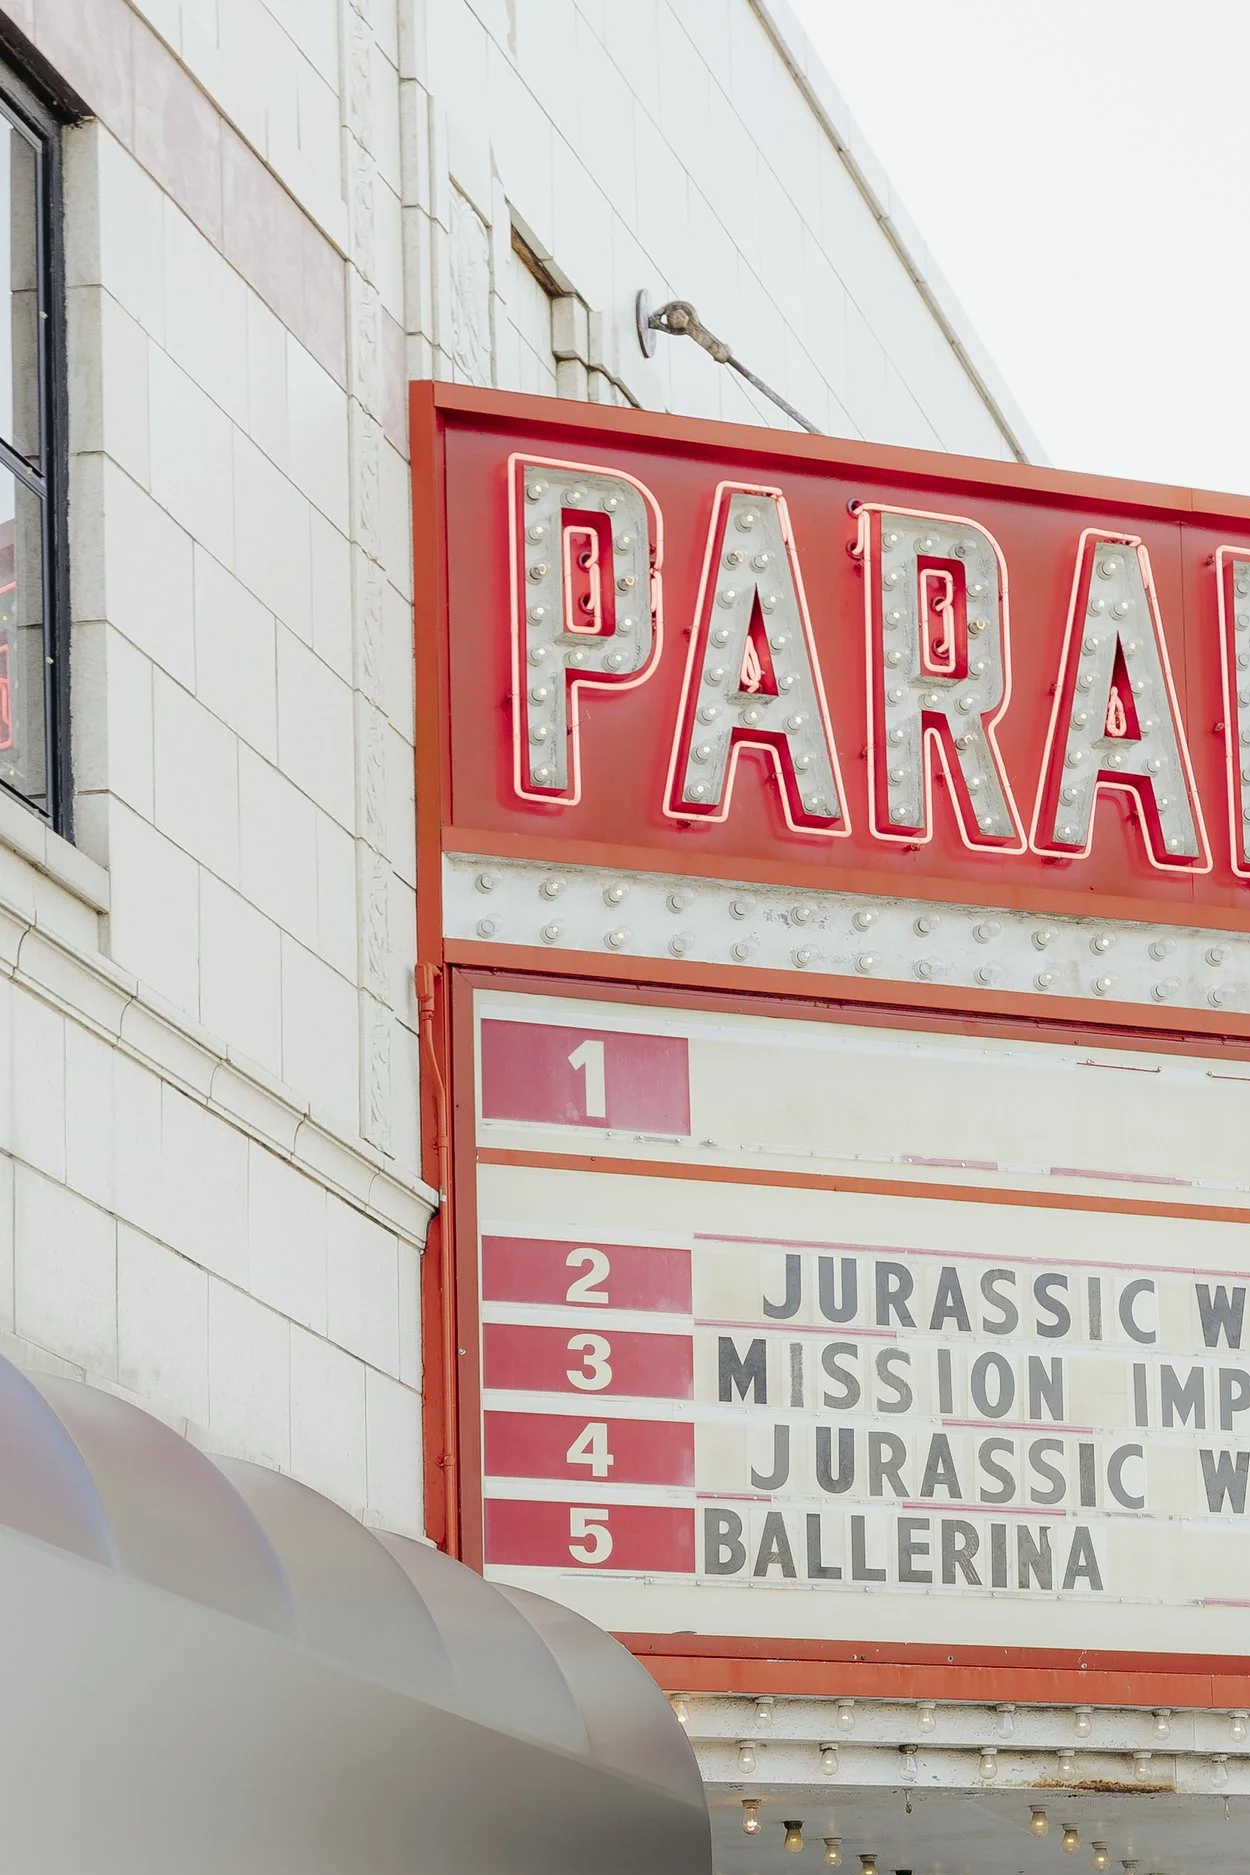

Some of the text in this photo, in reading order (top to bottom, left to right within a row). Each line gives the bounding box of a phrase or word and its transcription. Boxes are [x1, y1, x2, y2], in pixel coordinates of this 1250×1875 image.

[567, 1040, 606, 1118] 1
[565, 1249, 609, 1304] 2
[762, 1254, 1156, 1344] JURASSIC
[565, 1334, 612, 1391] 3
[718, 1336, 1064, 1422] MISSION
[566, 1422, 614, 1477] 4
[750, 1424, 1145, 1510] JURASSIC
[568, 1508, 613, 1564] 5
[704, 1508, 1104, 1591] BALLERINA
